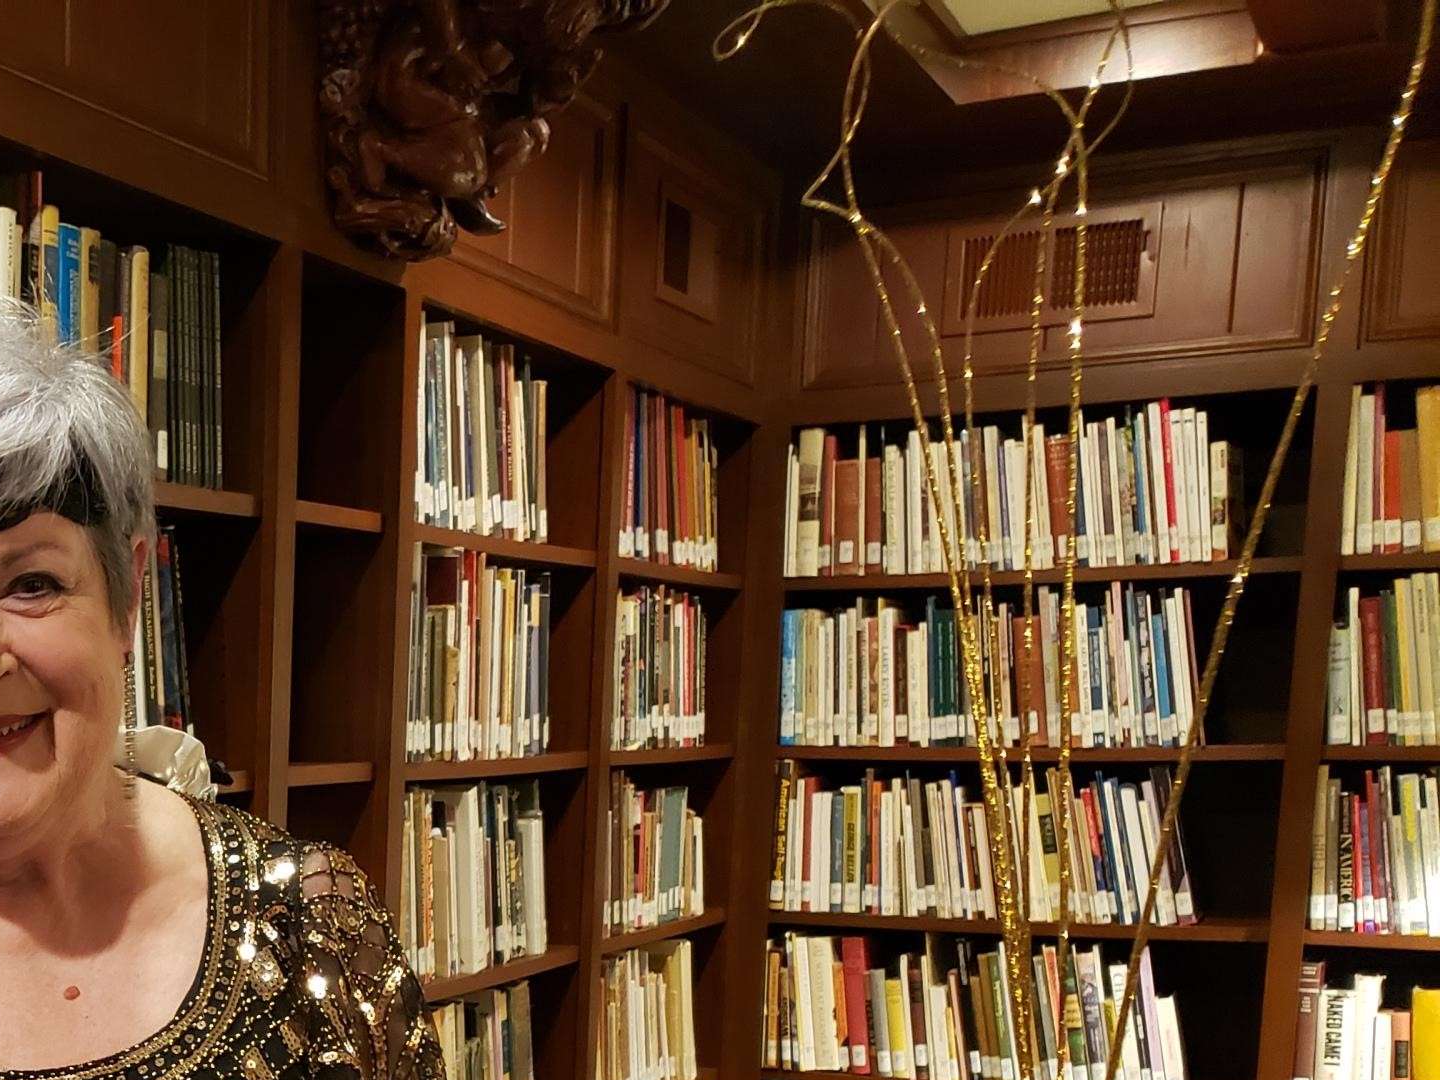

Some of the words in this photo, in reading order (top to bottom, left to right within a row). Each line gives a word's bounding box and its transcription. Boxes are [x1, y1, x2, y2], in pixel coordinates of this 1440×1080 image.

[777, 779, 791, 832] American
[773, 835, 786, 881] Self-Taugh
[1340, 834, 1353, 849] IN
[1340, 852, 1353, 902] AMERIC
[1325, 994, 1343, 1029] NAKED
[1324, 1031, 1342, 1060] CAME
